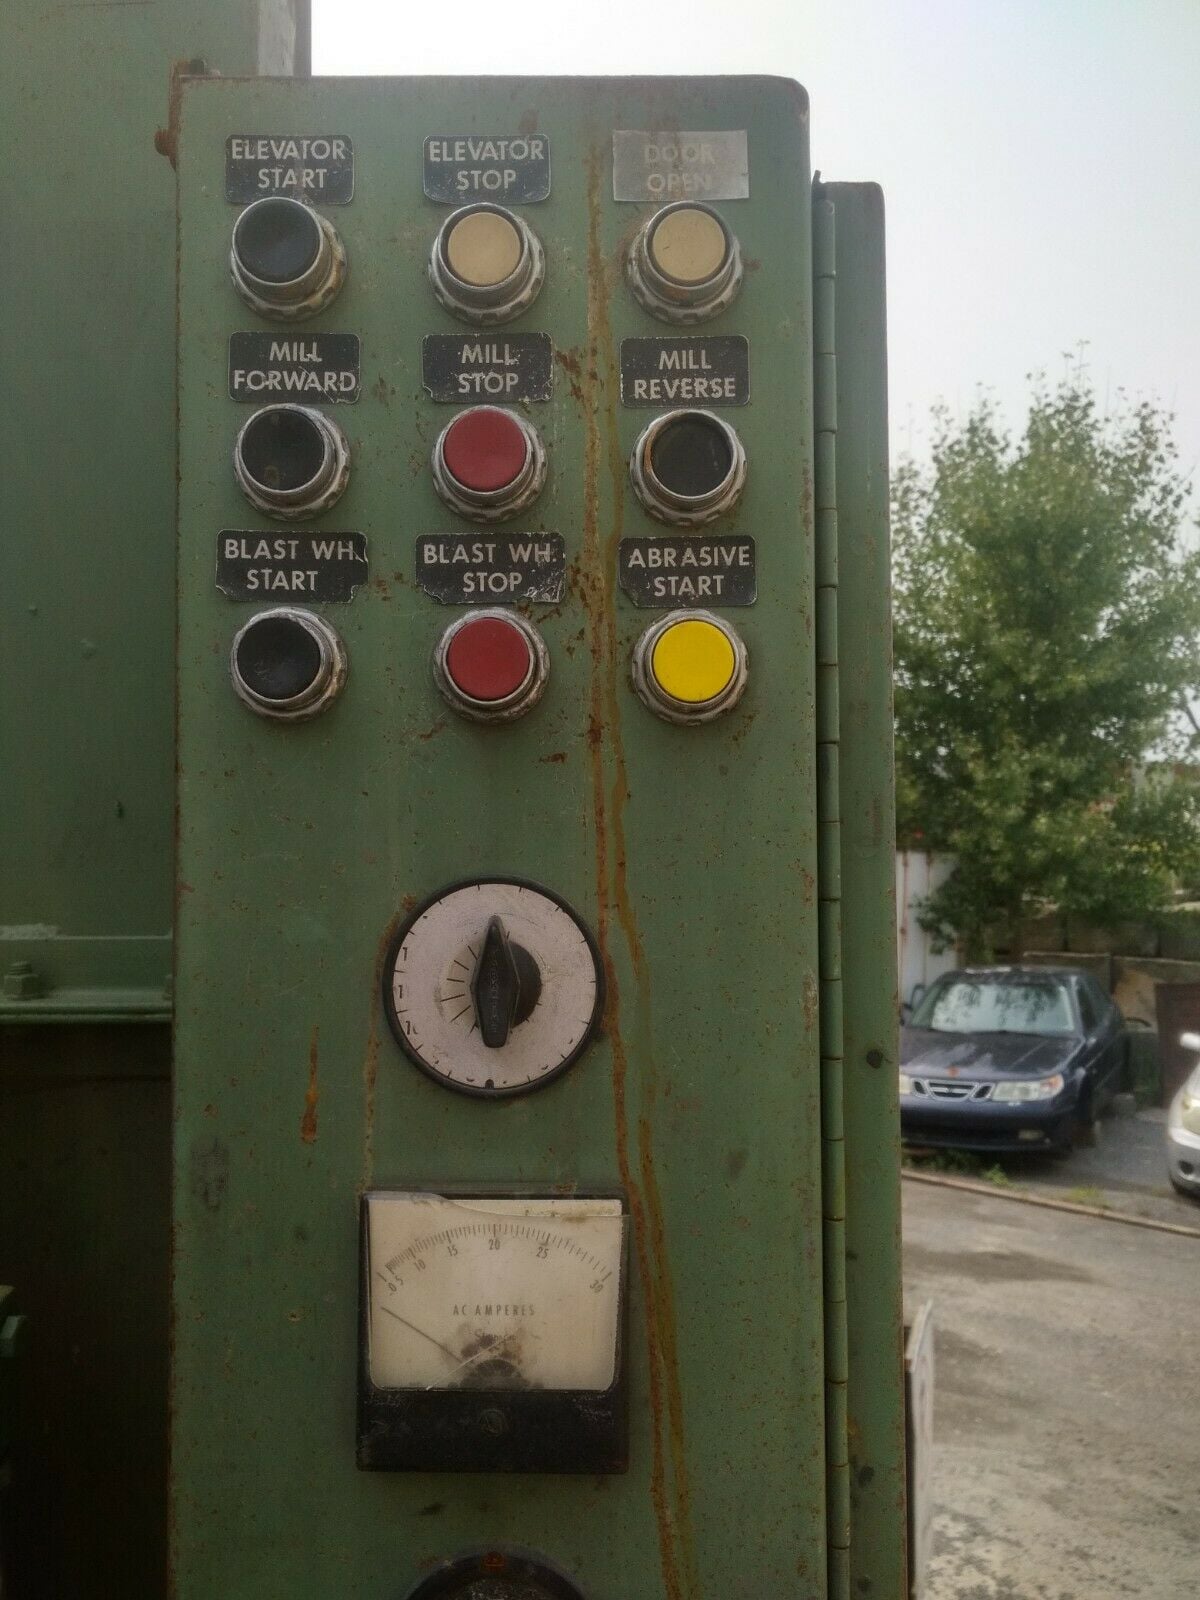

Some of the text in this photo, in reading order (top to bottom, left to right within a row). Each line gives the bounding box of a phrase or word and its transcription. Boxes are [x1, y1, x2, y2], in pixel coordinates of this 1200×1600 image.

[231, 139, 346, 160] ELEVATOR
[429, 139, 544, 161] ELEVATOR
[644, 144, 716, 164] DOOR
[258, 168, 327, 188] START
[456, 169, 517, 191] STOP
[647, 173, 713, 192] OPEN
[269, 341, 323, 362] MILL
[461, 343, 518, 366] MILL
[659, 350, 712, 370] MILL
[233, 369, 356, 392] FORWARD
[458, 372, 519, 394] STOP
[633, 377, 736, 400] REVERSE
[224, 538, 299, 560] BLAST
[423, 542, 557, 564] BLAST WH.
[627, 545, 750, 568] ABRASIVE
[246, 568, 318, 591] START
[462, 572, 522, 593] STOP
[653, 575, 725, 597] START
[447, 1244, 458, 1257] 15
[488, 1238, 501, 1251] 20
[535, 1246, 549, 1259] 25
[414, 1259, 426, 1272] 10
[395, 1275, 404, 1286] 5
[453, 1304, 535, 1316] AC AMPERES
